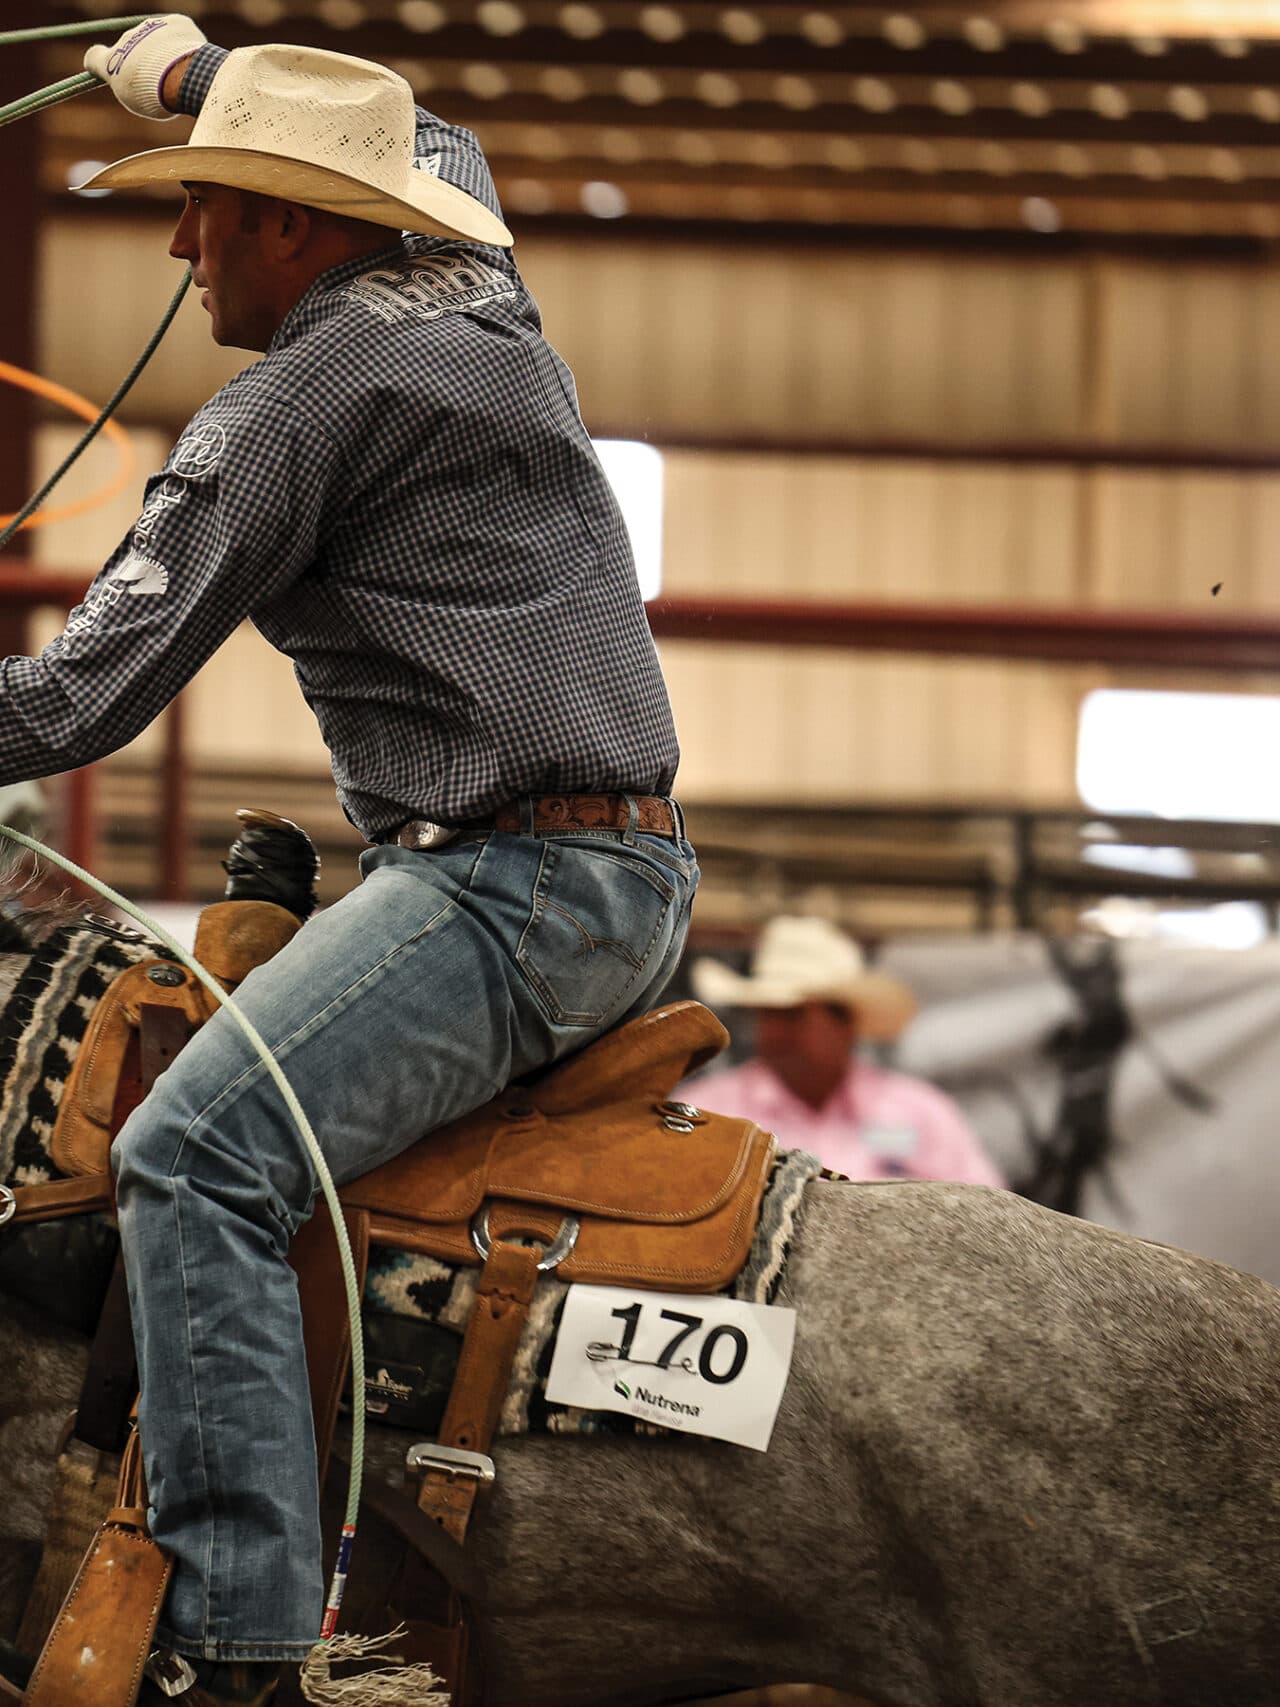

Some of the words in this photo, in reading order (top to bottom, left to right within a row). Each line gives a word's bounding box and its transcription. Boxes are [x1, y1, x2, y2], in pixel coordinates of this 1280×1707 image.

[133, 477, 188, 549] Classic
[611, 1303, 748, 1385] 170
[634, 1386, 701, 1417] Nutrena
